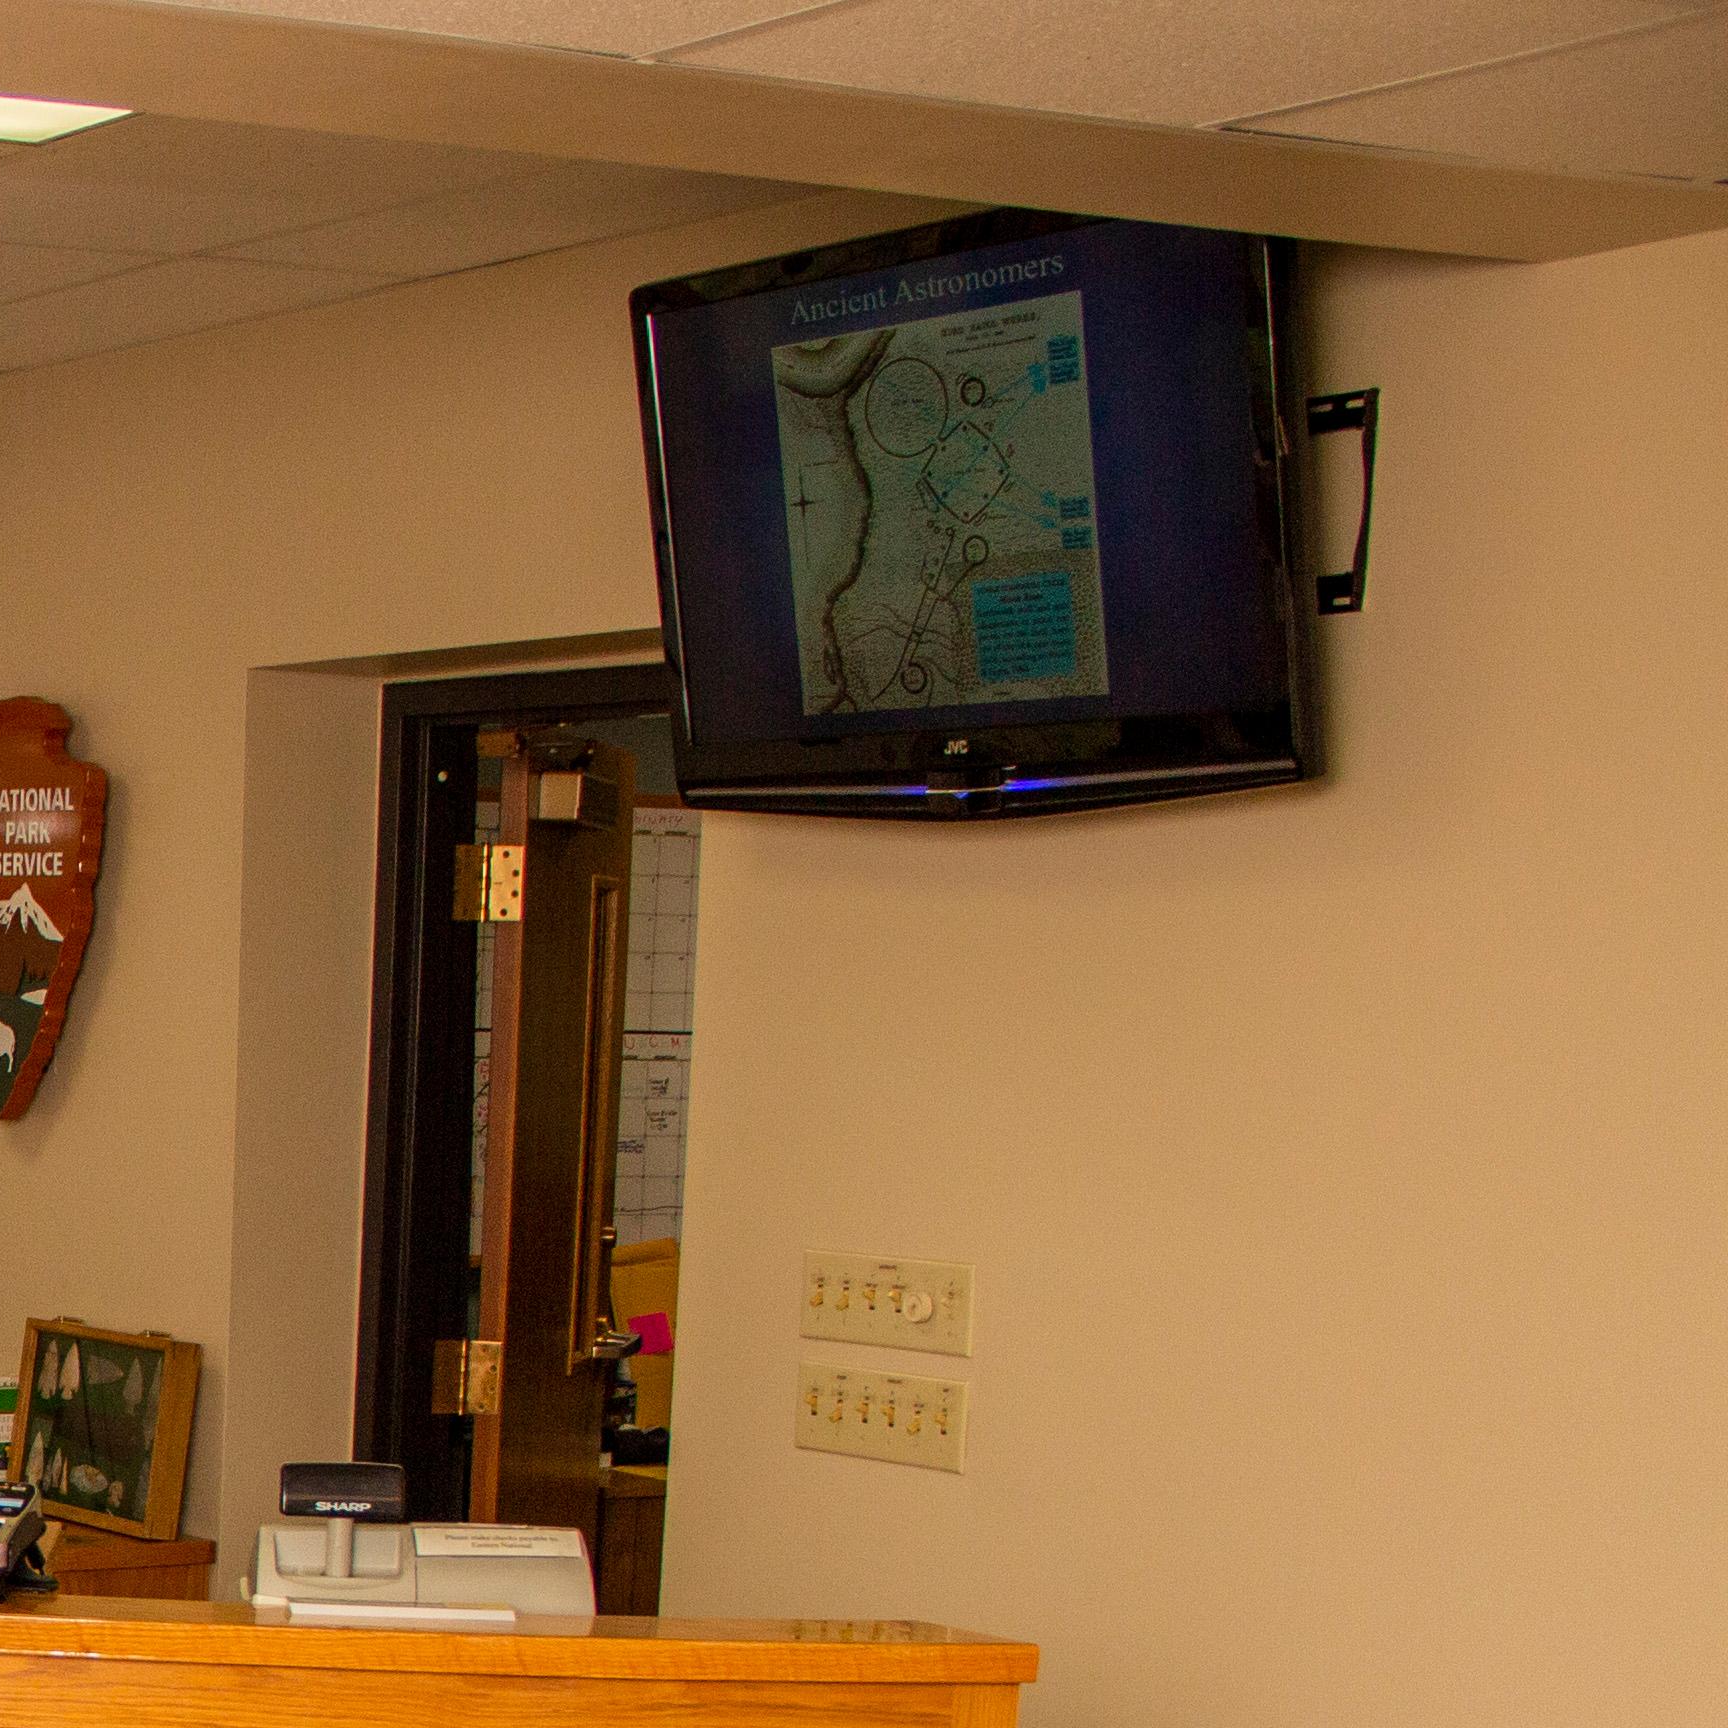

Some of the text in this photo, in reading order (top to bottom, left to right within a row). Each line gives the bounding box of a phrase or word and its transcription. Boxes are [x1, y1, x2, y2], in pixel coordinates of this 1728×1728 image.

[792, 255, 1065, 325] Ancient Astronomers
[944, 740, 968, 755] JVC
[5, 821, 51, 845] PARK
[315, 1501, 372, 1513] SHARP
